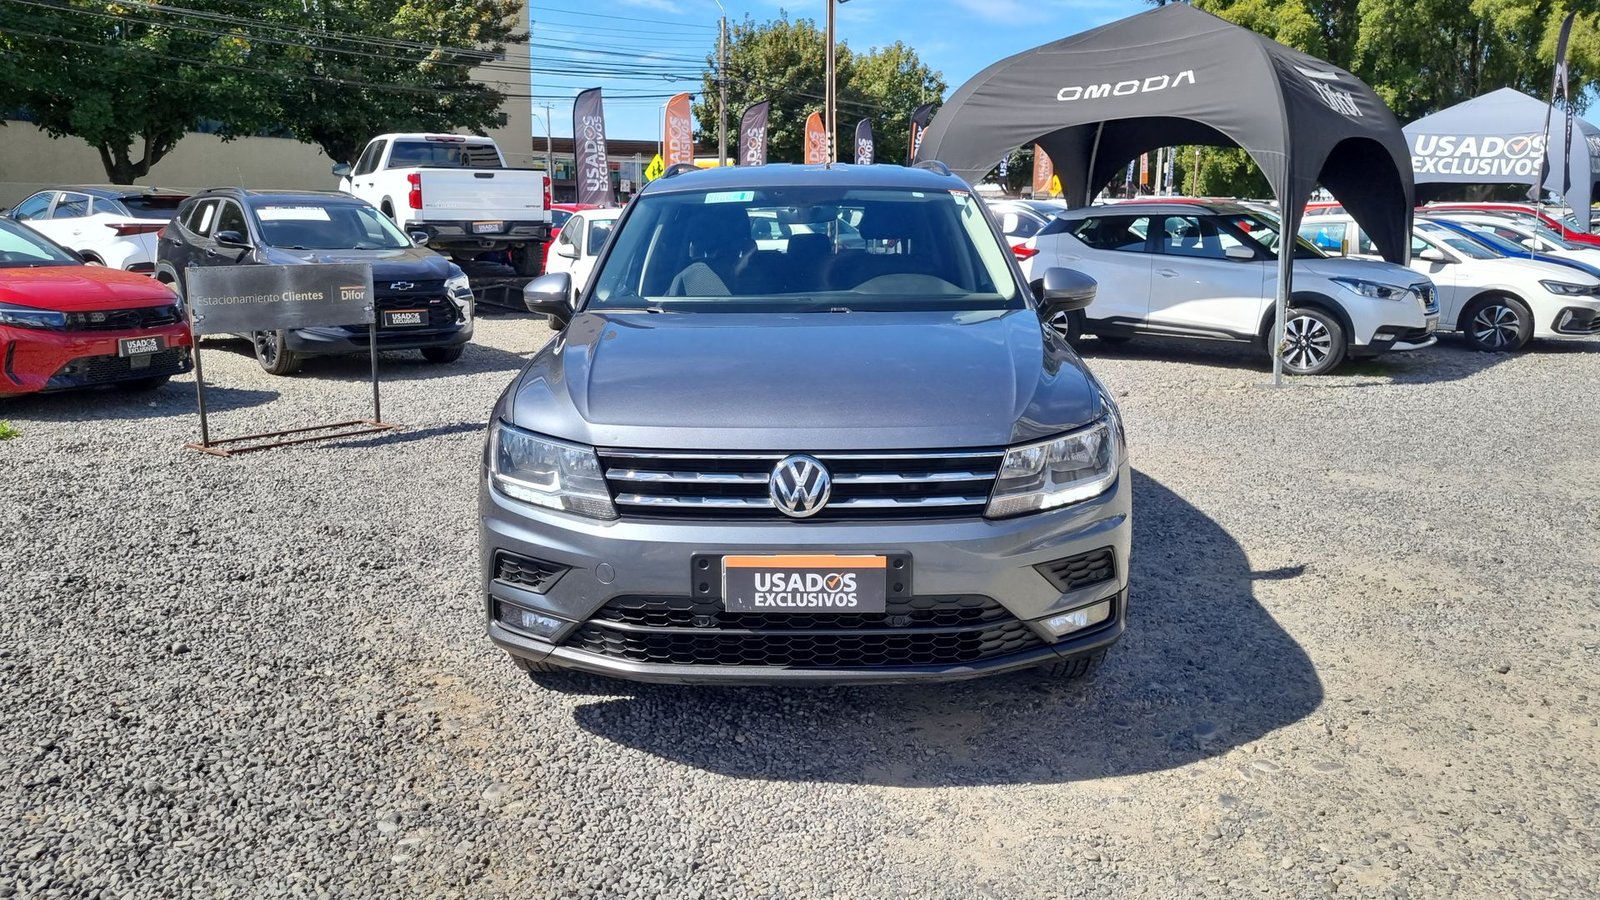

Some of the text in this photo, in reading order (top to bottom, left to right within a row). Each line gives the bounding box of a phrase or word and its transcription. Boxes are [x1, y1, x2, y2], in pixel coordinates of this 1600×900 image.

[1056, 69, 1196, 102] OMODA
[669, 116, 682, 165] ADOS
[1414, 133, 1550, 159] USADOS
[583, 115, 599, 192] USADOS
[594, 115, 609, 192] EXCLUSIVOS
[1411, 156, 1544, 176] EXCLUSIVOS
[197, 290, 365, 306] Estacionamiento Clientes Difor
[127, 338, 157, 348] USADOS
[128, 345, 158, 354] EXCLUSIVOS
[754, 572, 858, 593] USADOS
[754, 592, 858, 607] EXCLUSIVOS
